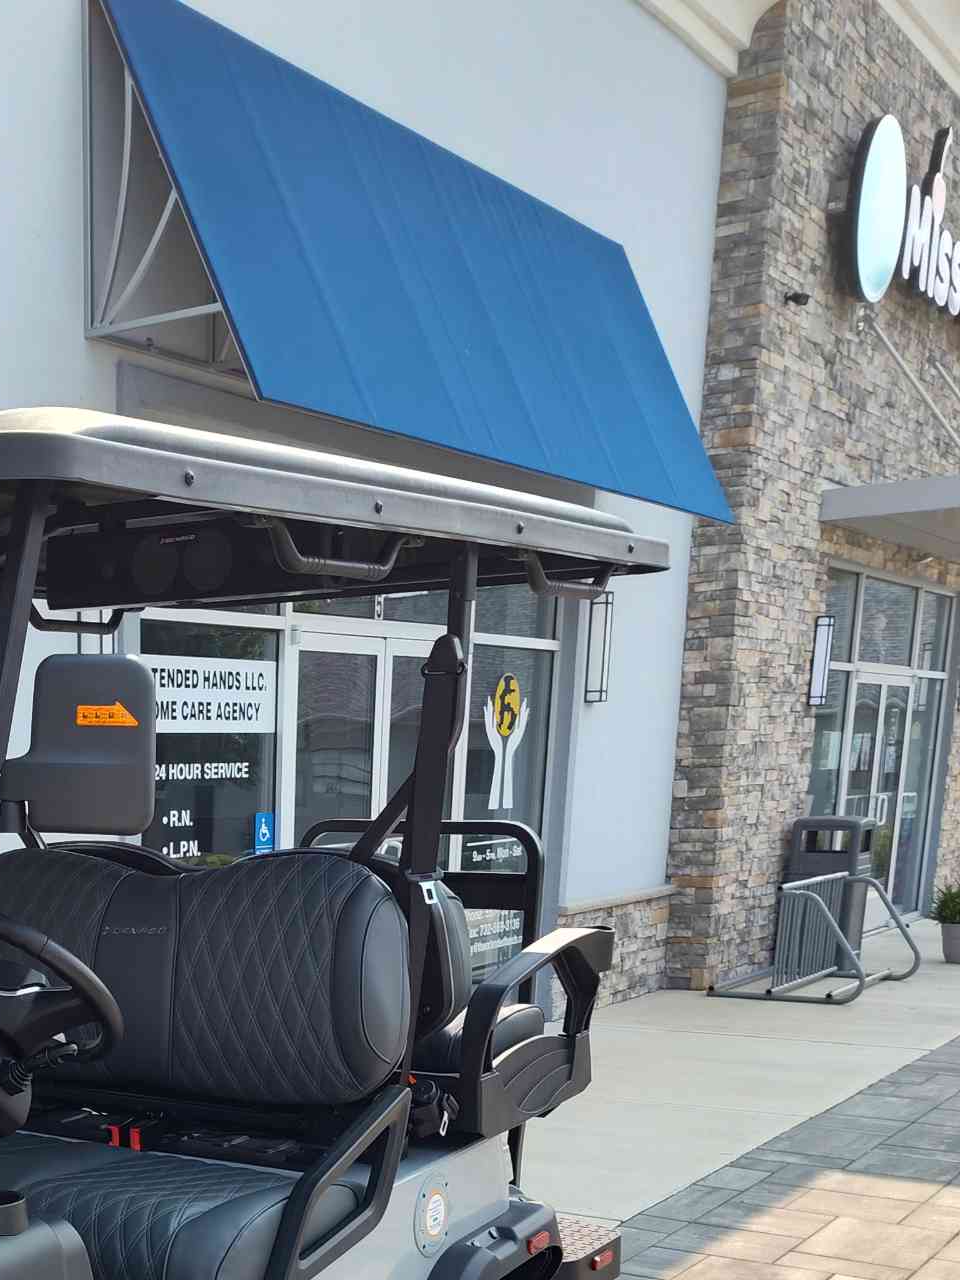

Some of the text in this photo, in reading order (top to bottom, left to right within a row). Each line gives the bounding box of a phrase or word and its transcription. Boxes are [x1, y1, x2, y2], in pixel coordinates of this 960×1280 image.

[152, 668, 200, 689] TENDED
[203, 670, 241, 690] HANDS
[155, 701, 261, 721] OME CARE AGENCY
[155, 762, 249, 780] 24 HOUR SERVICE
